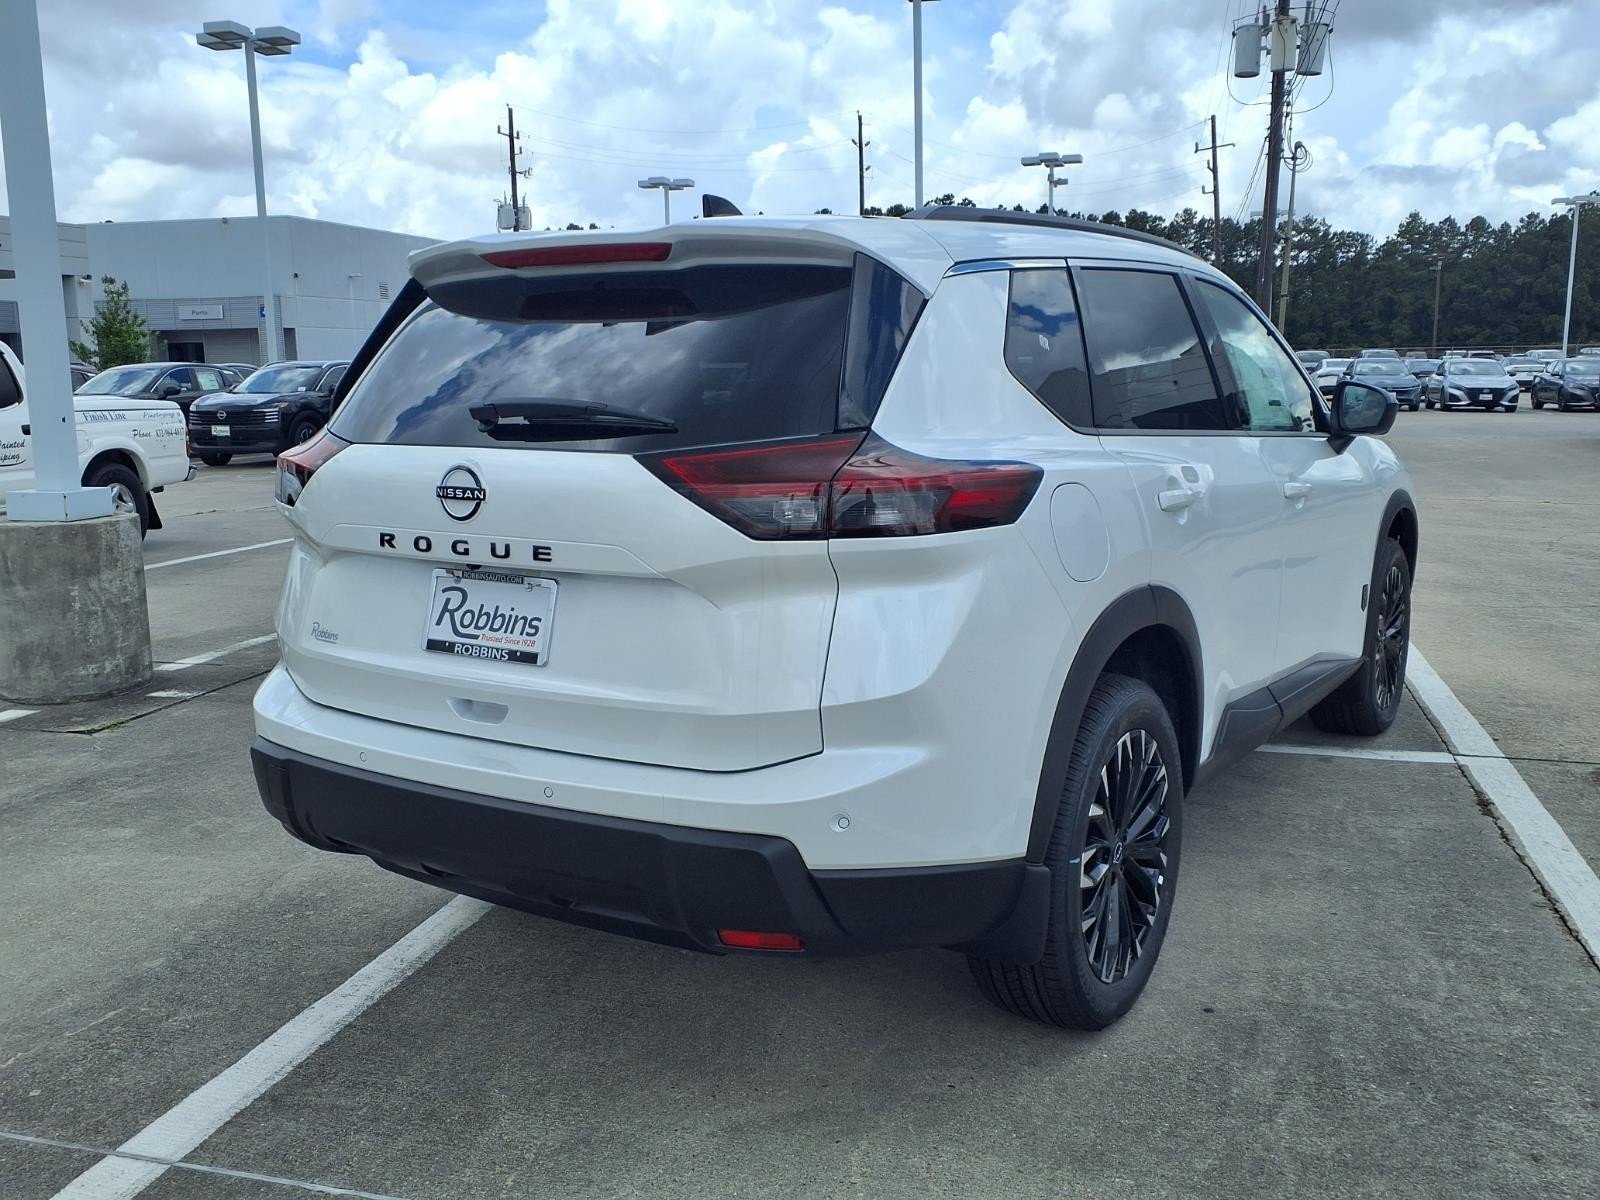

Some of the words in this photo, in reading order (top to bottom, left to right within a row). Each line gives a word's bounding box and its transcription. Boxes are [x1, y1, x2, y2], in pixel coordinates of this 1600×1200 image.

[82, 411, 108, 421] Finish
[108, 411, 127, 420] Line
[132, 429, 151, 438] Phone
[437, 487, 484, 499] NISSAN
[379, 532, 553, 562] ROGUE
[463, 571, 523, 584] ROBBINSAUTO.COM
[435, 586, 542, 640] Robbins
[310, 621, 338, 644] Robbins
[481, 633, 503, 643] Trusted
[504, 636, 521, 645] Since
[521, 639, 536, 647] 1928
[454, 643, 509, 660] ROBBINS
